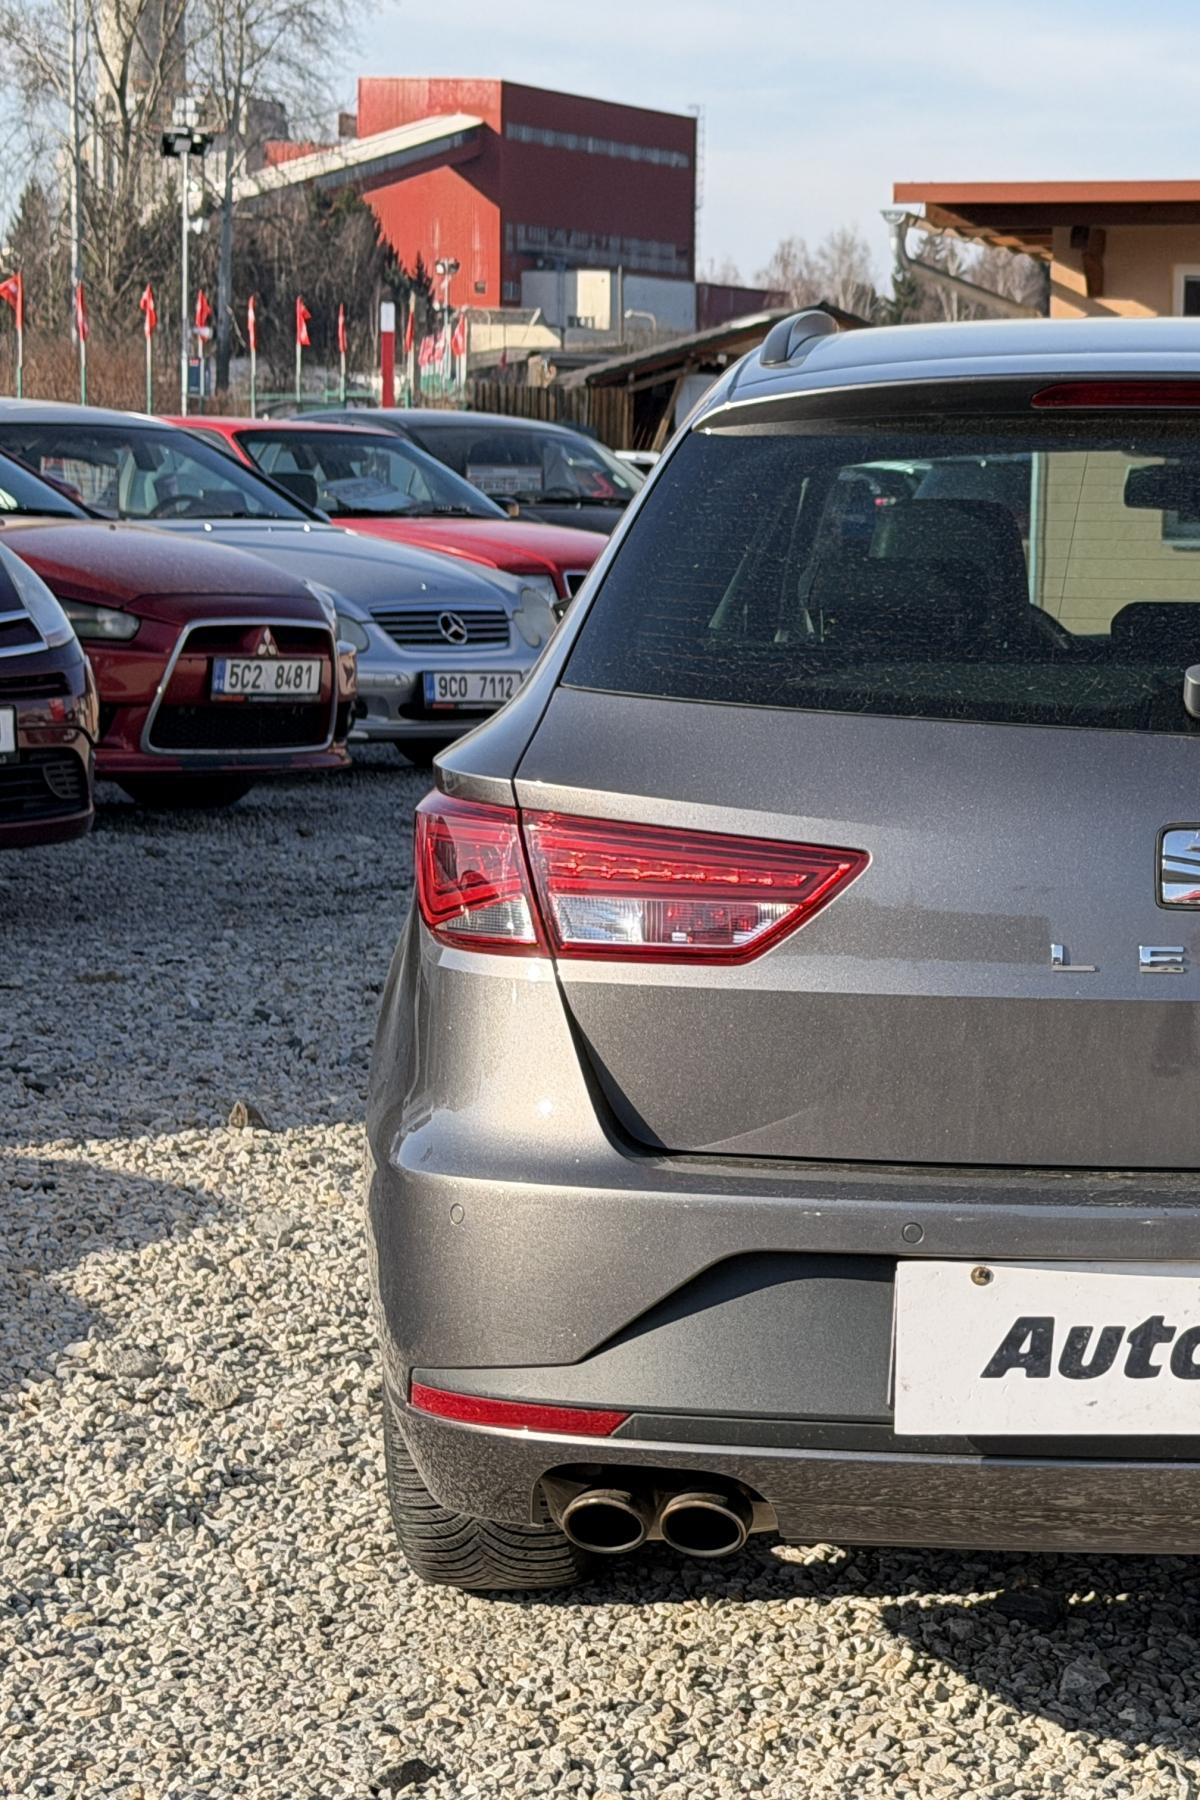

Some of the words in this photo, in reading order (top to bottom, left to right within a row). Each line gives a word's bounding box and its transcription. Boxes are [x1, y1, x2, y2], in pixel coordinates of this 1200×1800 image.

[229, 663, 263, 689] 5C2
[274, 664, 313, 689] 8481
[480, 676, 514, 699] 7112
